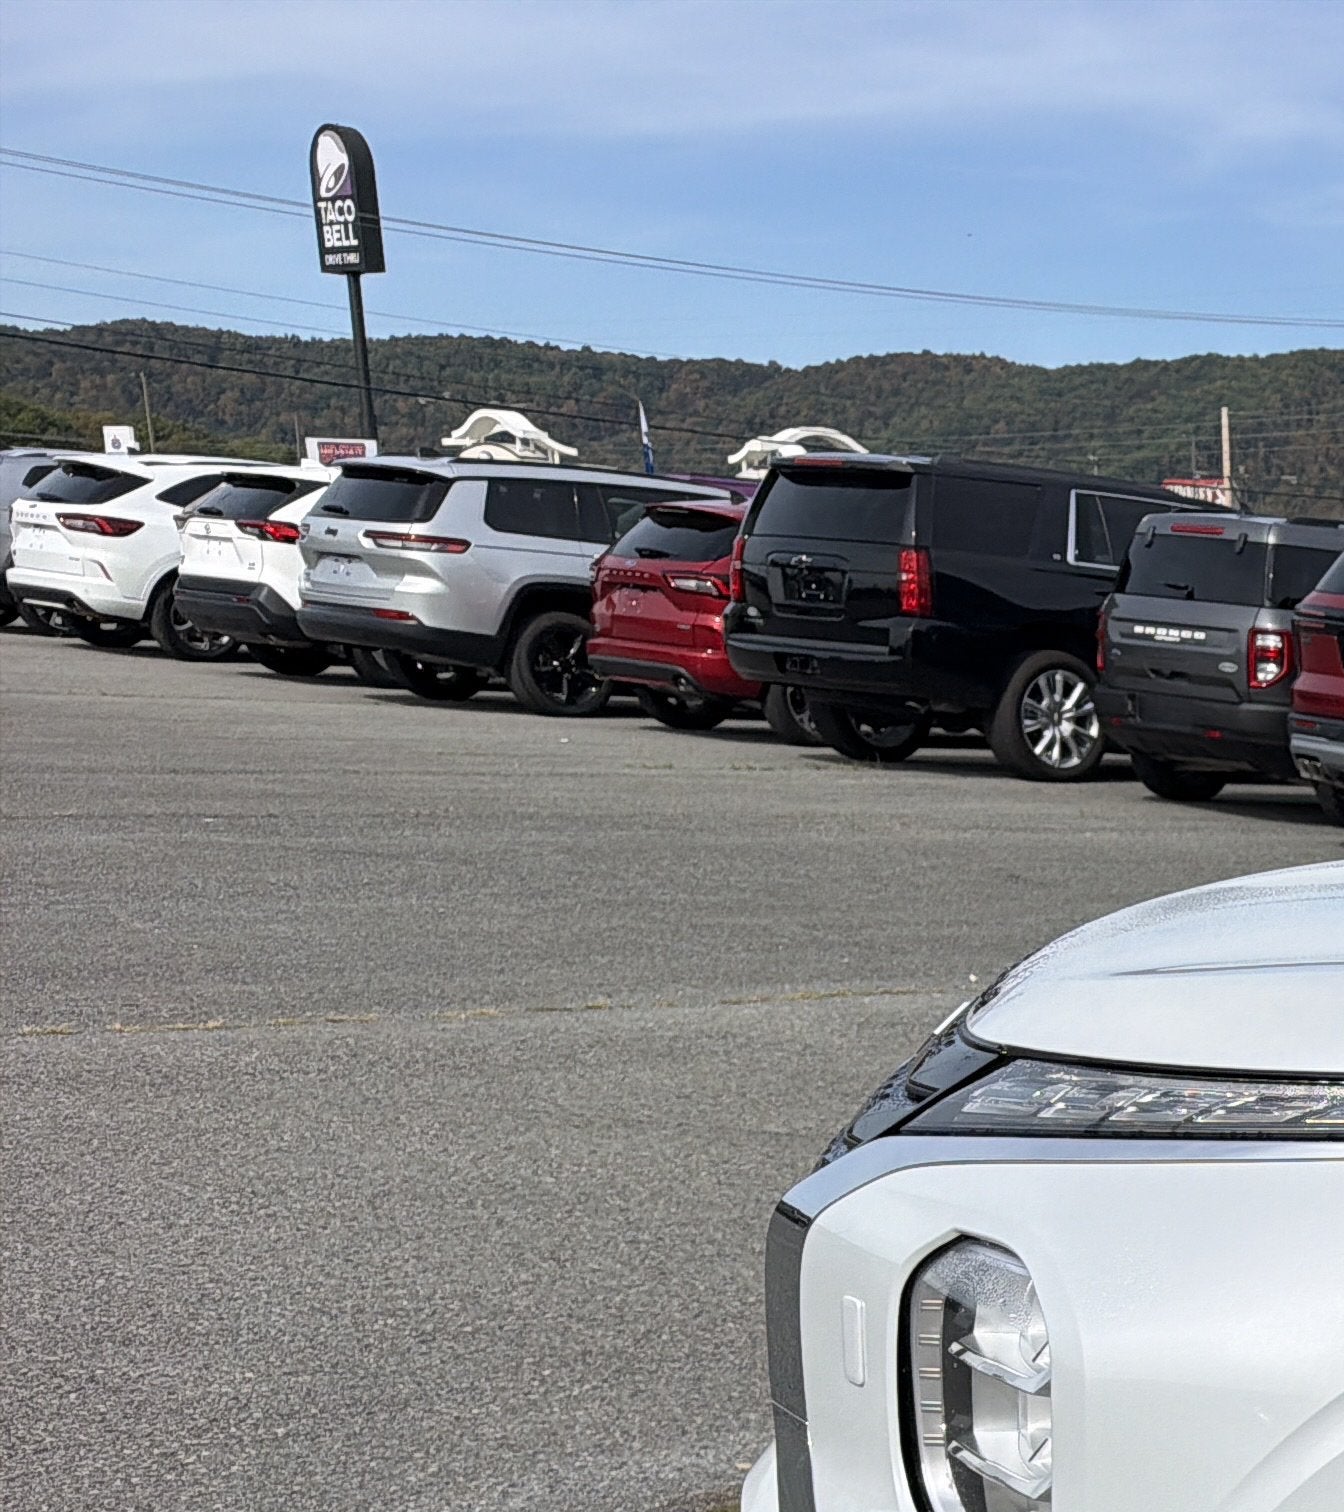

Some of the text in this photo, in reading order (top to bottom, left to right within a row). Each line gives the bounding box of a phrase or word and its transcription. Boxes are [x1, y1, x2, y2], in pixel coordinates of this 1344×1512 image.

[317, 199, 355, 224] TACO
[323, 223, 359, 248] BELL
[325, 252, 360, 266] DRIVE THRU
[1133, 625, 1206, 640] BRONCO
